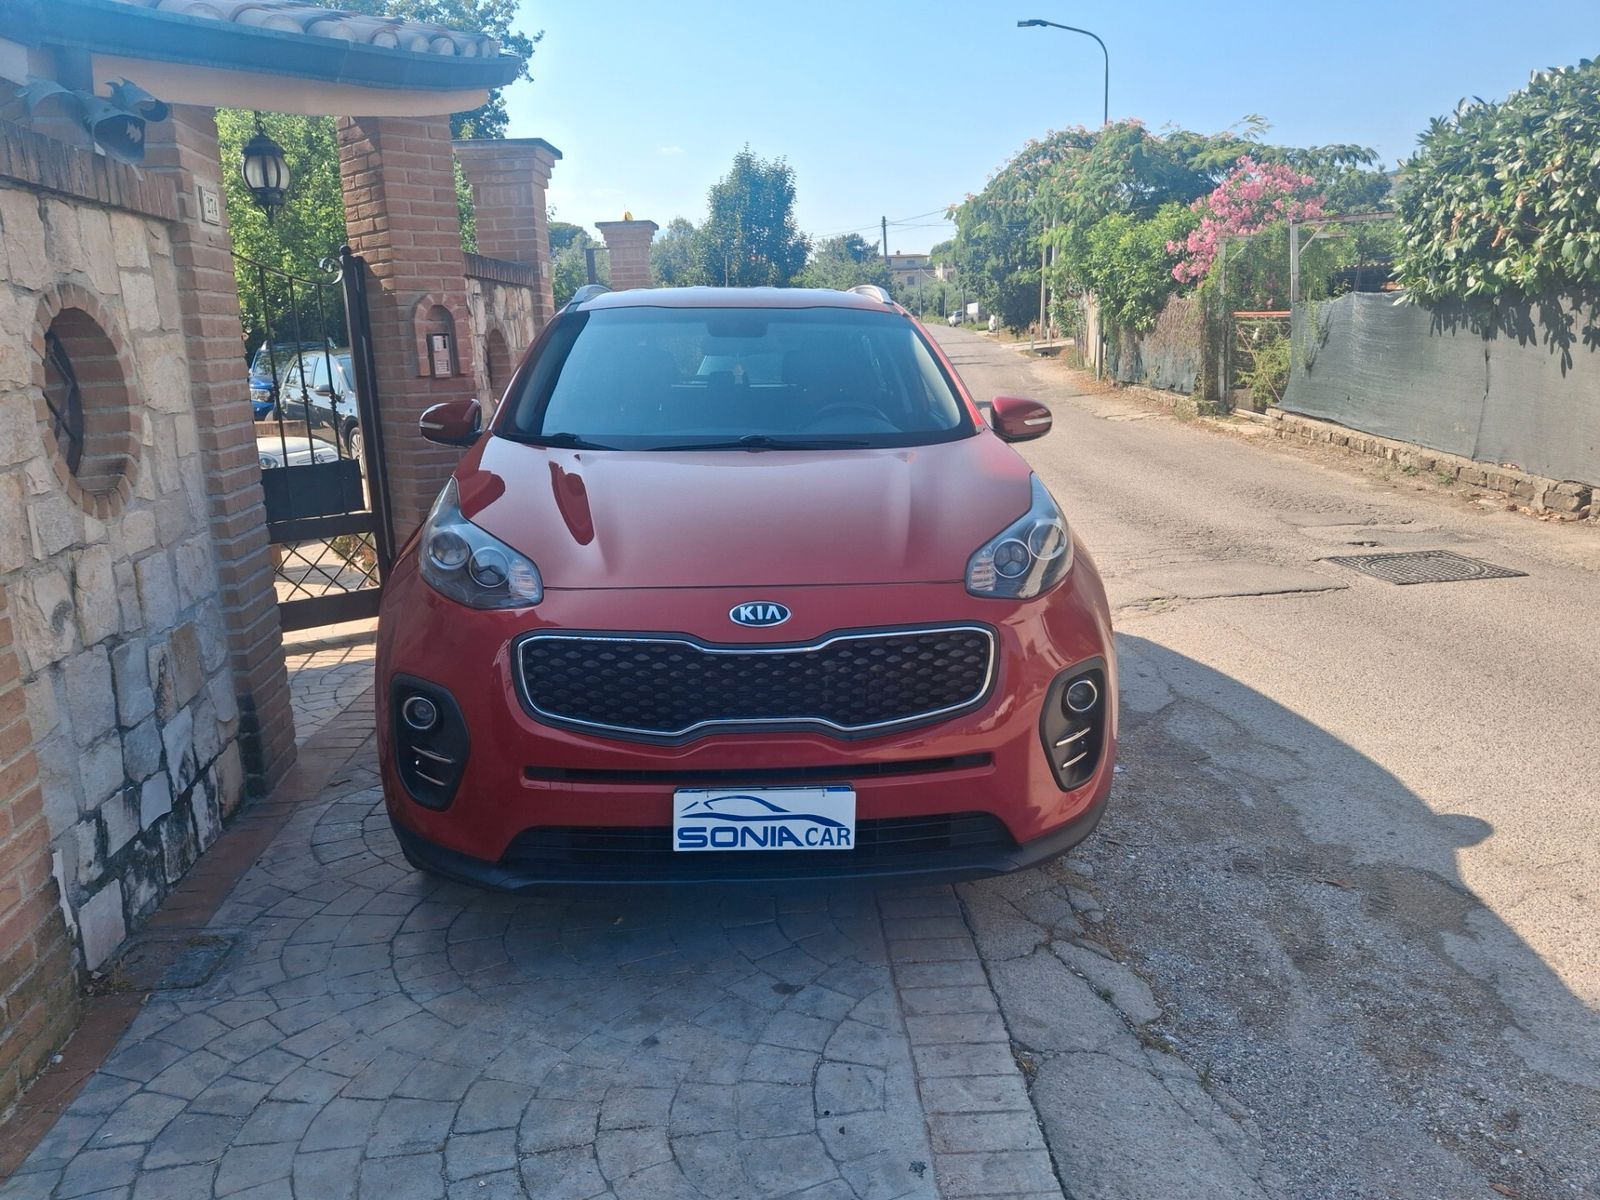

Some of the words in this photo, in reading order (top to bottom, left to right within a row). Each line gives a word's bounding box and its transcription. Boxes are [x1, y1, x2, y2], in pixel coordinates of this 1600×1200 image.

[740, 605, 781, 621] KIA
[677, 826, 804, 848] SONIA
[805, 827, 851, 847] CAR
